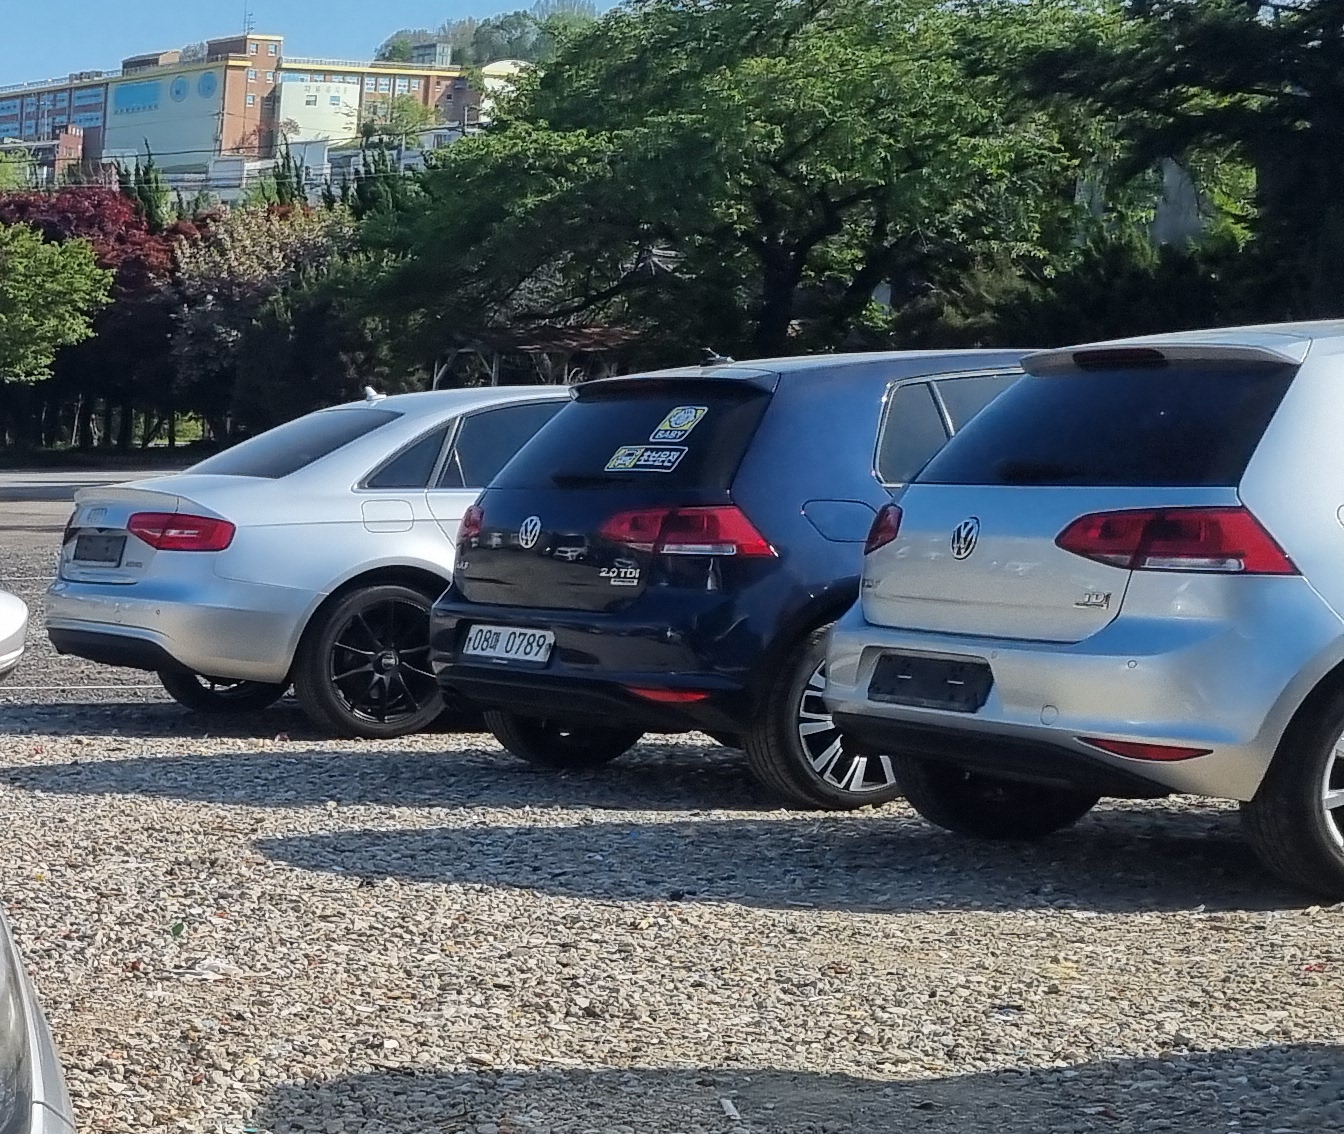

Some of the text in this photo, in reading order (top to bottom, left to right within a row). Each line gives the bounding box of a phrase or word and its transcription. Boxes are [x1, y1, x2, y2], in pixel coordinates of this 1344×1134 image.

[654, 430, 686, 439] BABY
[636, 450, 681, 467] 초보운전
[619, 568, 641, 578] TDI
[504, 631, 547, 657] 0789
